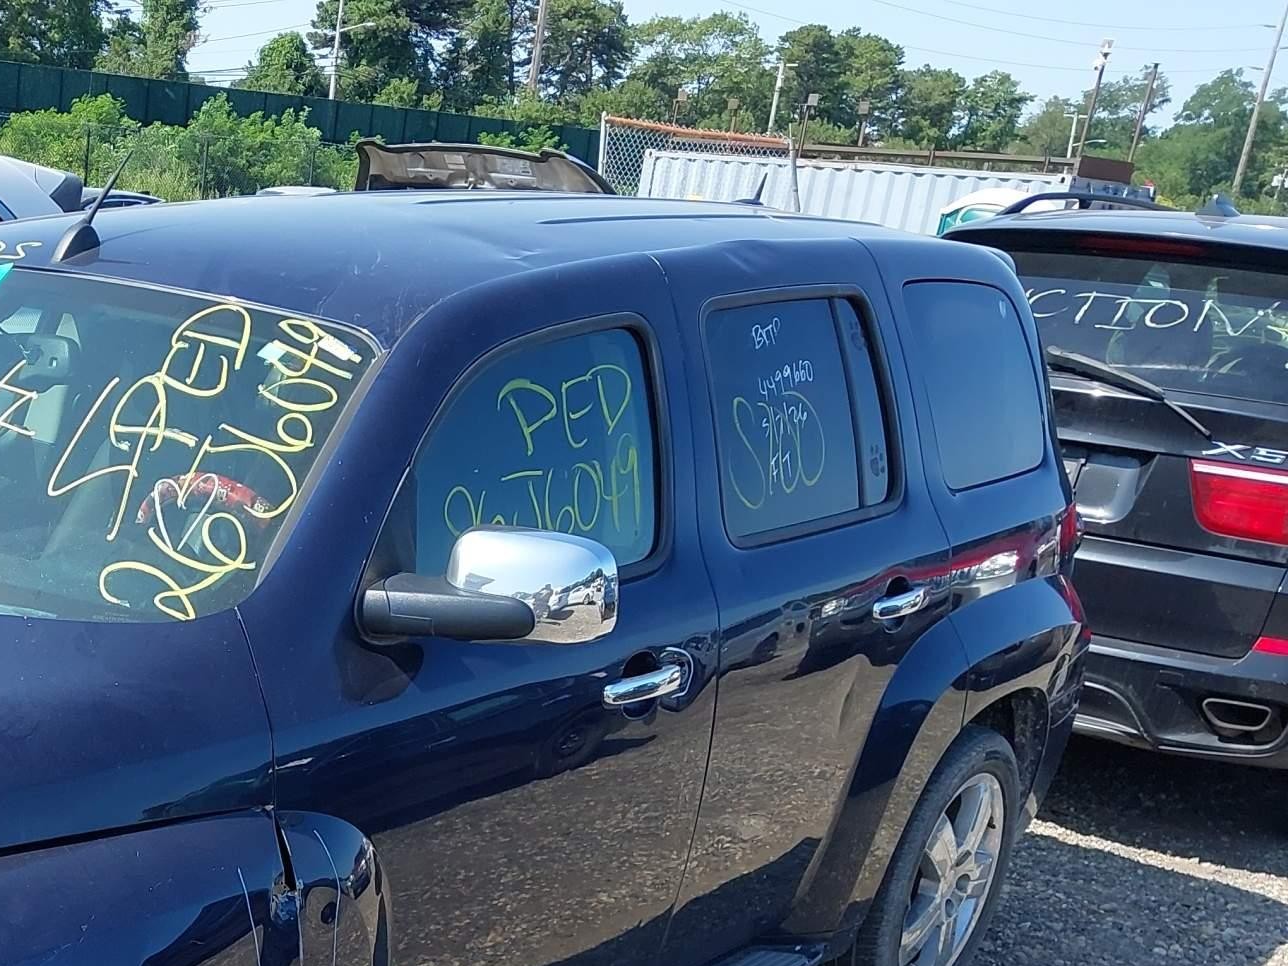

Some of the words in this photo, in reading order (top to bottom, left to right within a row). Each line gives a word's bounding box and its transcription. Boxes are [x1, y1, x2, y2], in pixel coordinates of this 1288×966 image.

[1025, 288, 1282, 338] CTION
[497, 363, 632, 457] PED
[1202, 440, 1288, 464] X5
